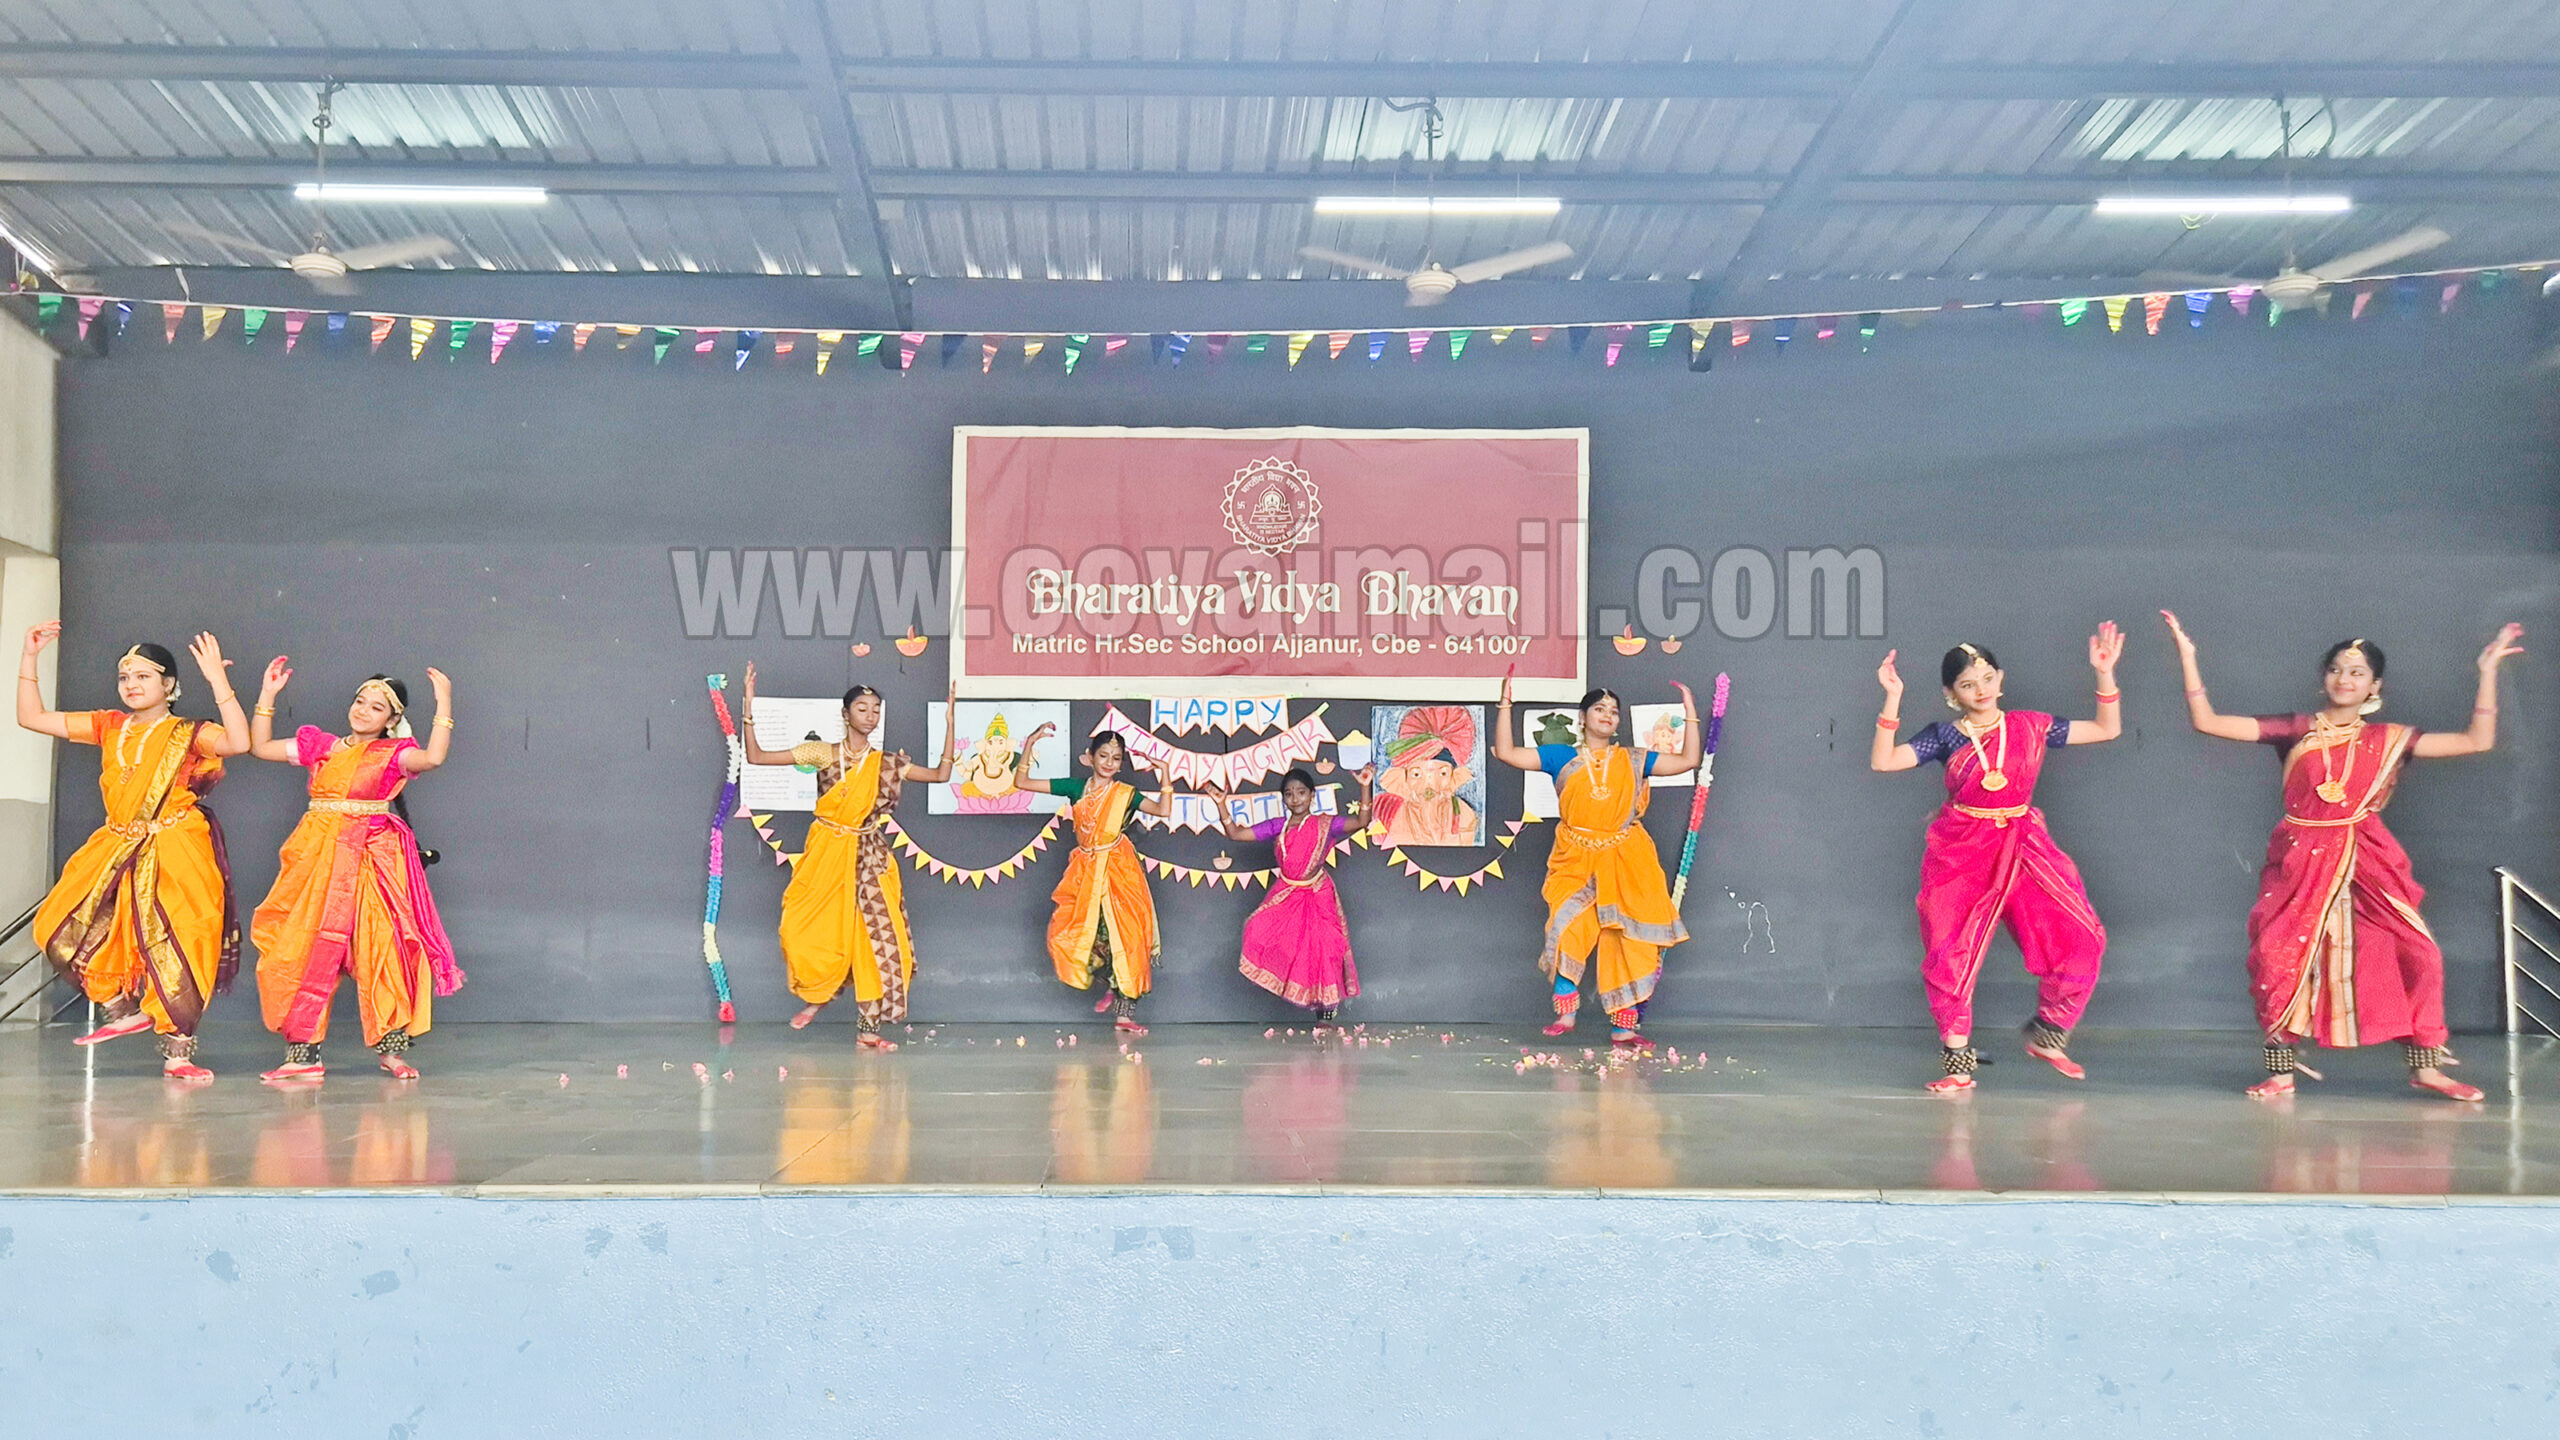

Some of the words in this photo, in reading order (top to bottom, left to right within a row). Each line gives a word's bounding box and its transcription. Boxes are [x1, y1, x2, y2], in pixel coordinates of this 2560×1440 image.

[1026, 568, 1226, 626] Bharatiya
[1233, 569, 1341, 625] Vidya
[1360, 569, 1519, 626] Bhavan
[1012, 633, 1088, 654] Matric
[1094, 632, 1174, 654] Hr.Sec
[1180, 632, 1265, 654] School
[1271, 632, 1363, 659] Ajjanur,
[1371, 633, 1421, 655] Cbe
[1444, 635, 1532, 655] 641007
[1154, 698, 1282, 726] HAPPY
